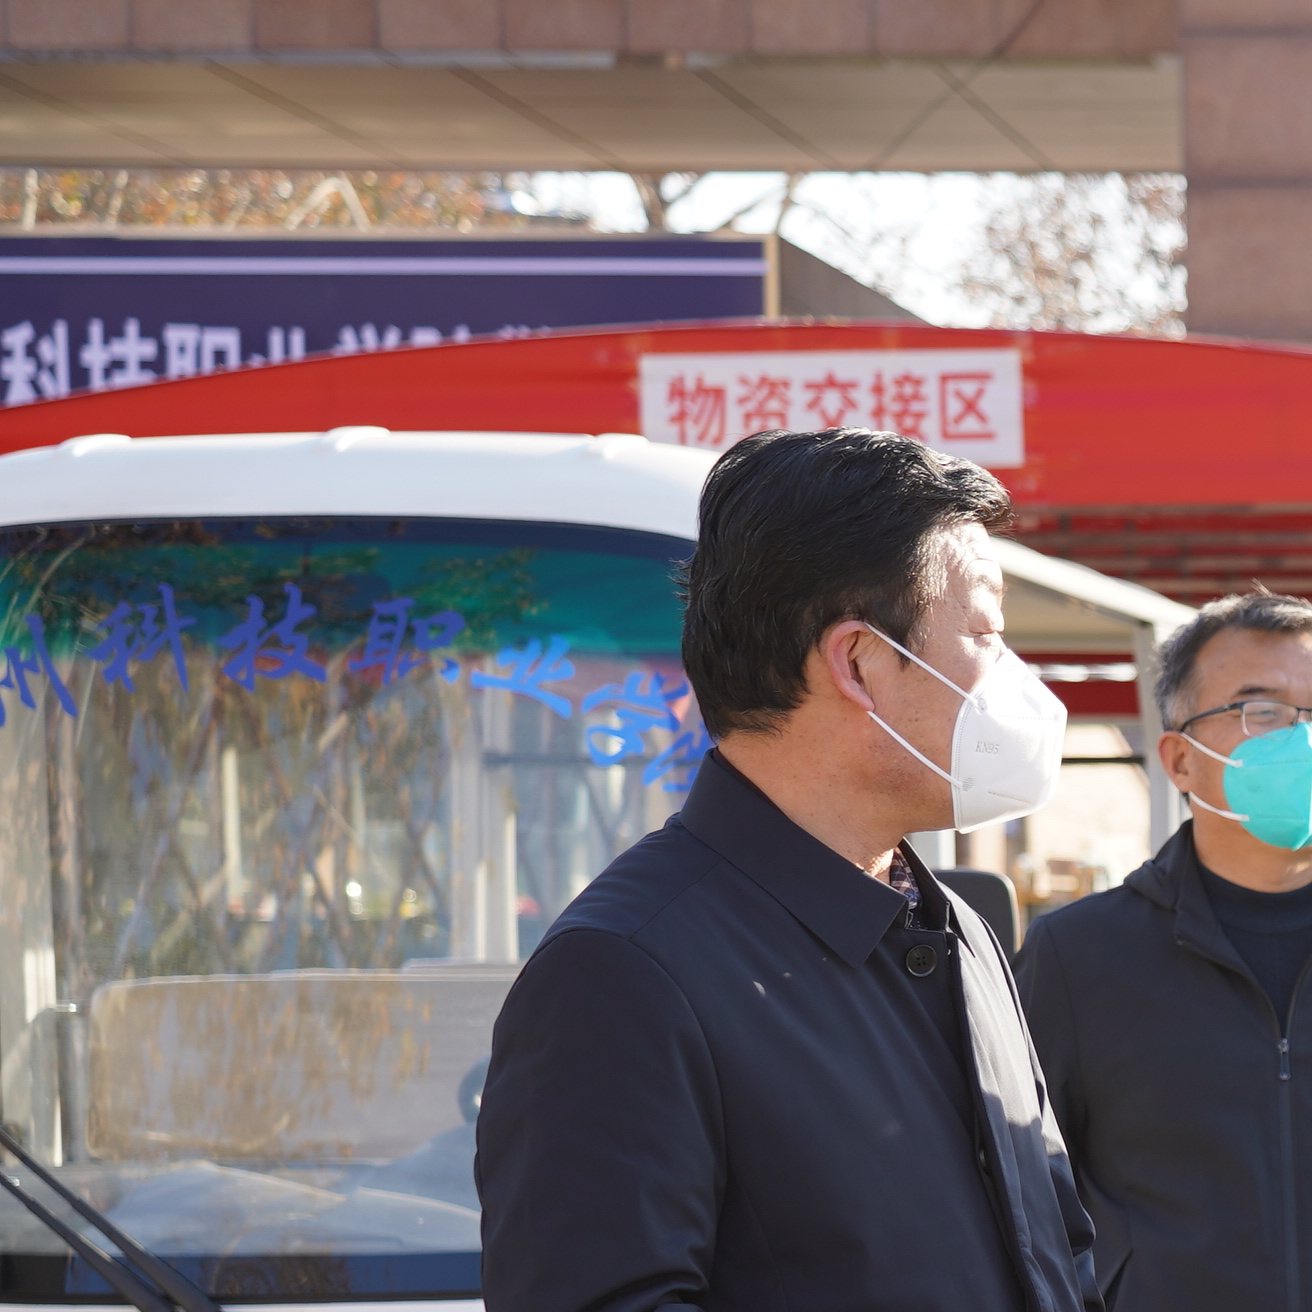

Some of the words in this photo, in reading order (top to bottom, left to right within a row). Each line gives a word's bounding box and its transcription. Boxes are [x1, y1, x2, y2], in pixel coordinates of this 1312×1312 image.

[666, 369, 997, 446] 物资交接区
[975, 740, 1000, 755] KN95
